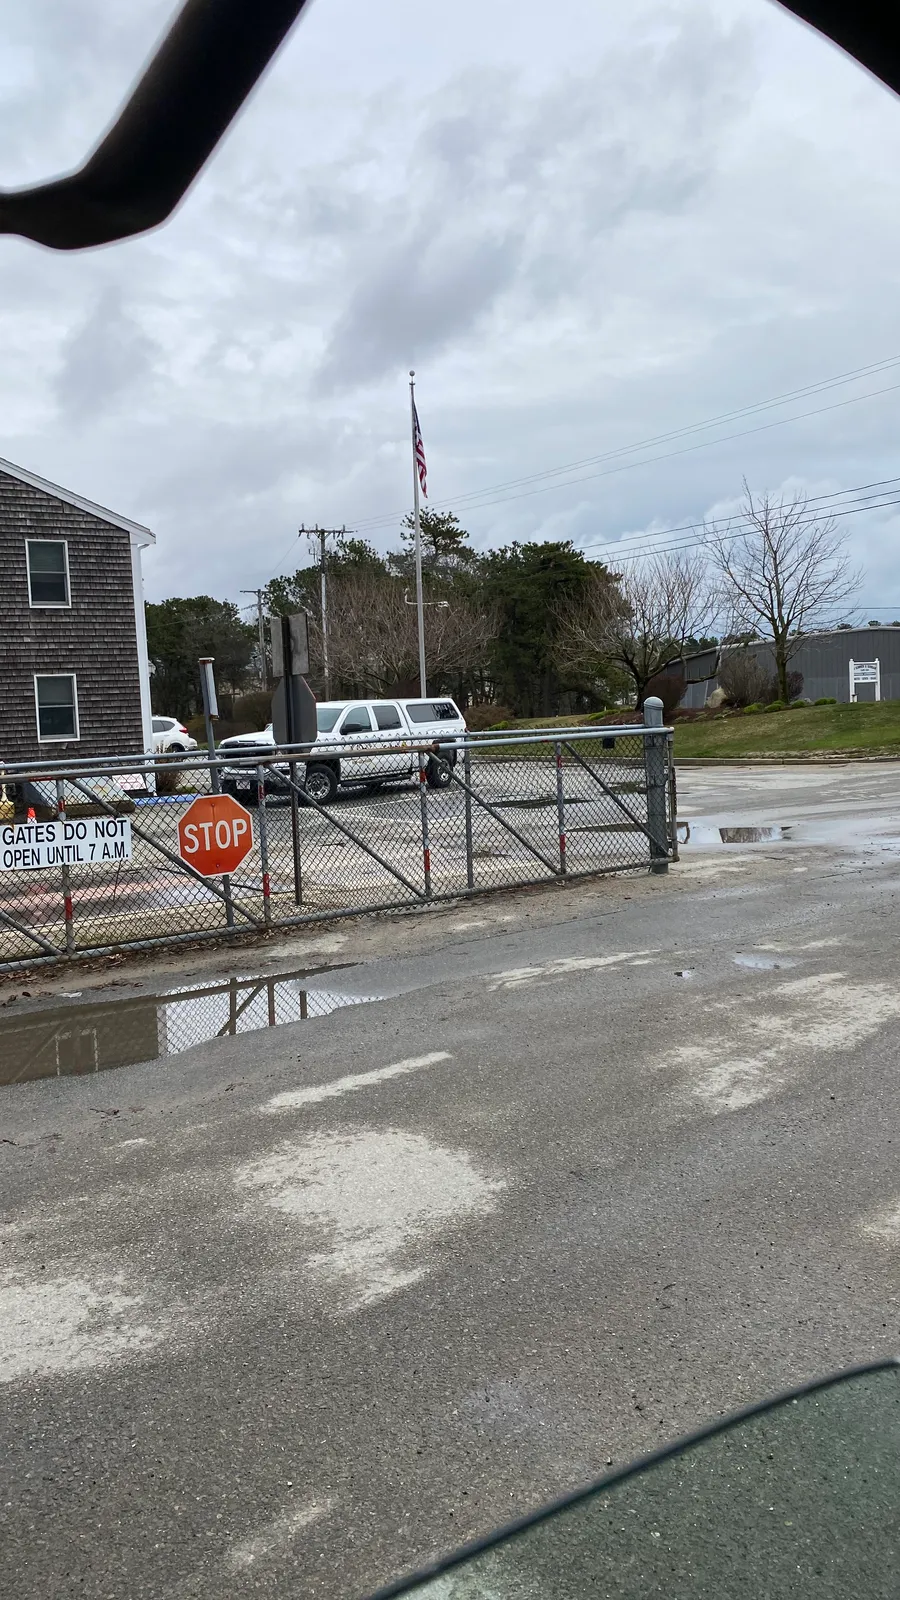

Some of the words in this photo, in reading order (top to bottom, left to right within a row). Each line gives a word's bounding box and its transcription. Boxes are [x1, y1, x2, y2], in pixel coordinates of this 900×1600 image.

[2, 825, 56, 845] GATES
[64, 822, 87, 840] DO
[95, 820, 127, 838] NOT
[184, 819, 247, 853] STOP
[3, 847, 41, 868] OPEN
[47, 844, 83, 863] UNTIL
[89, 843, 96, 860] 7
[102, 841, 129, 859] A.M.
